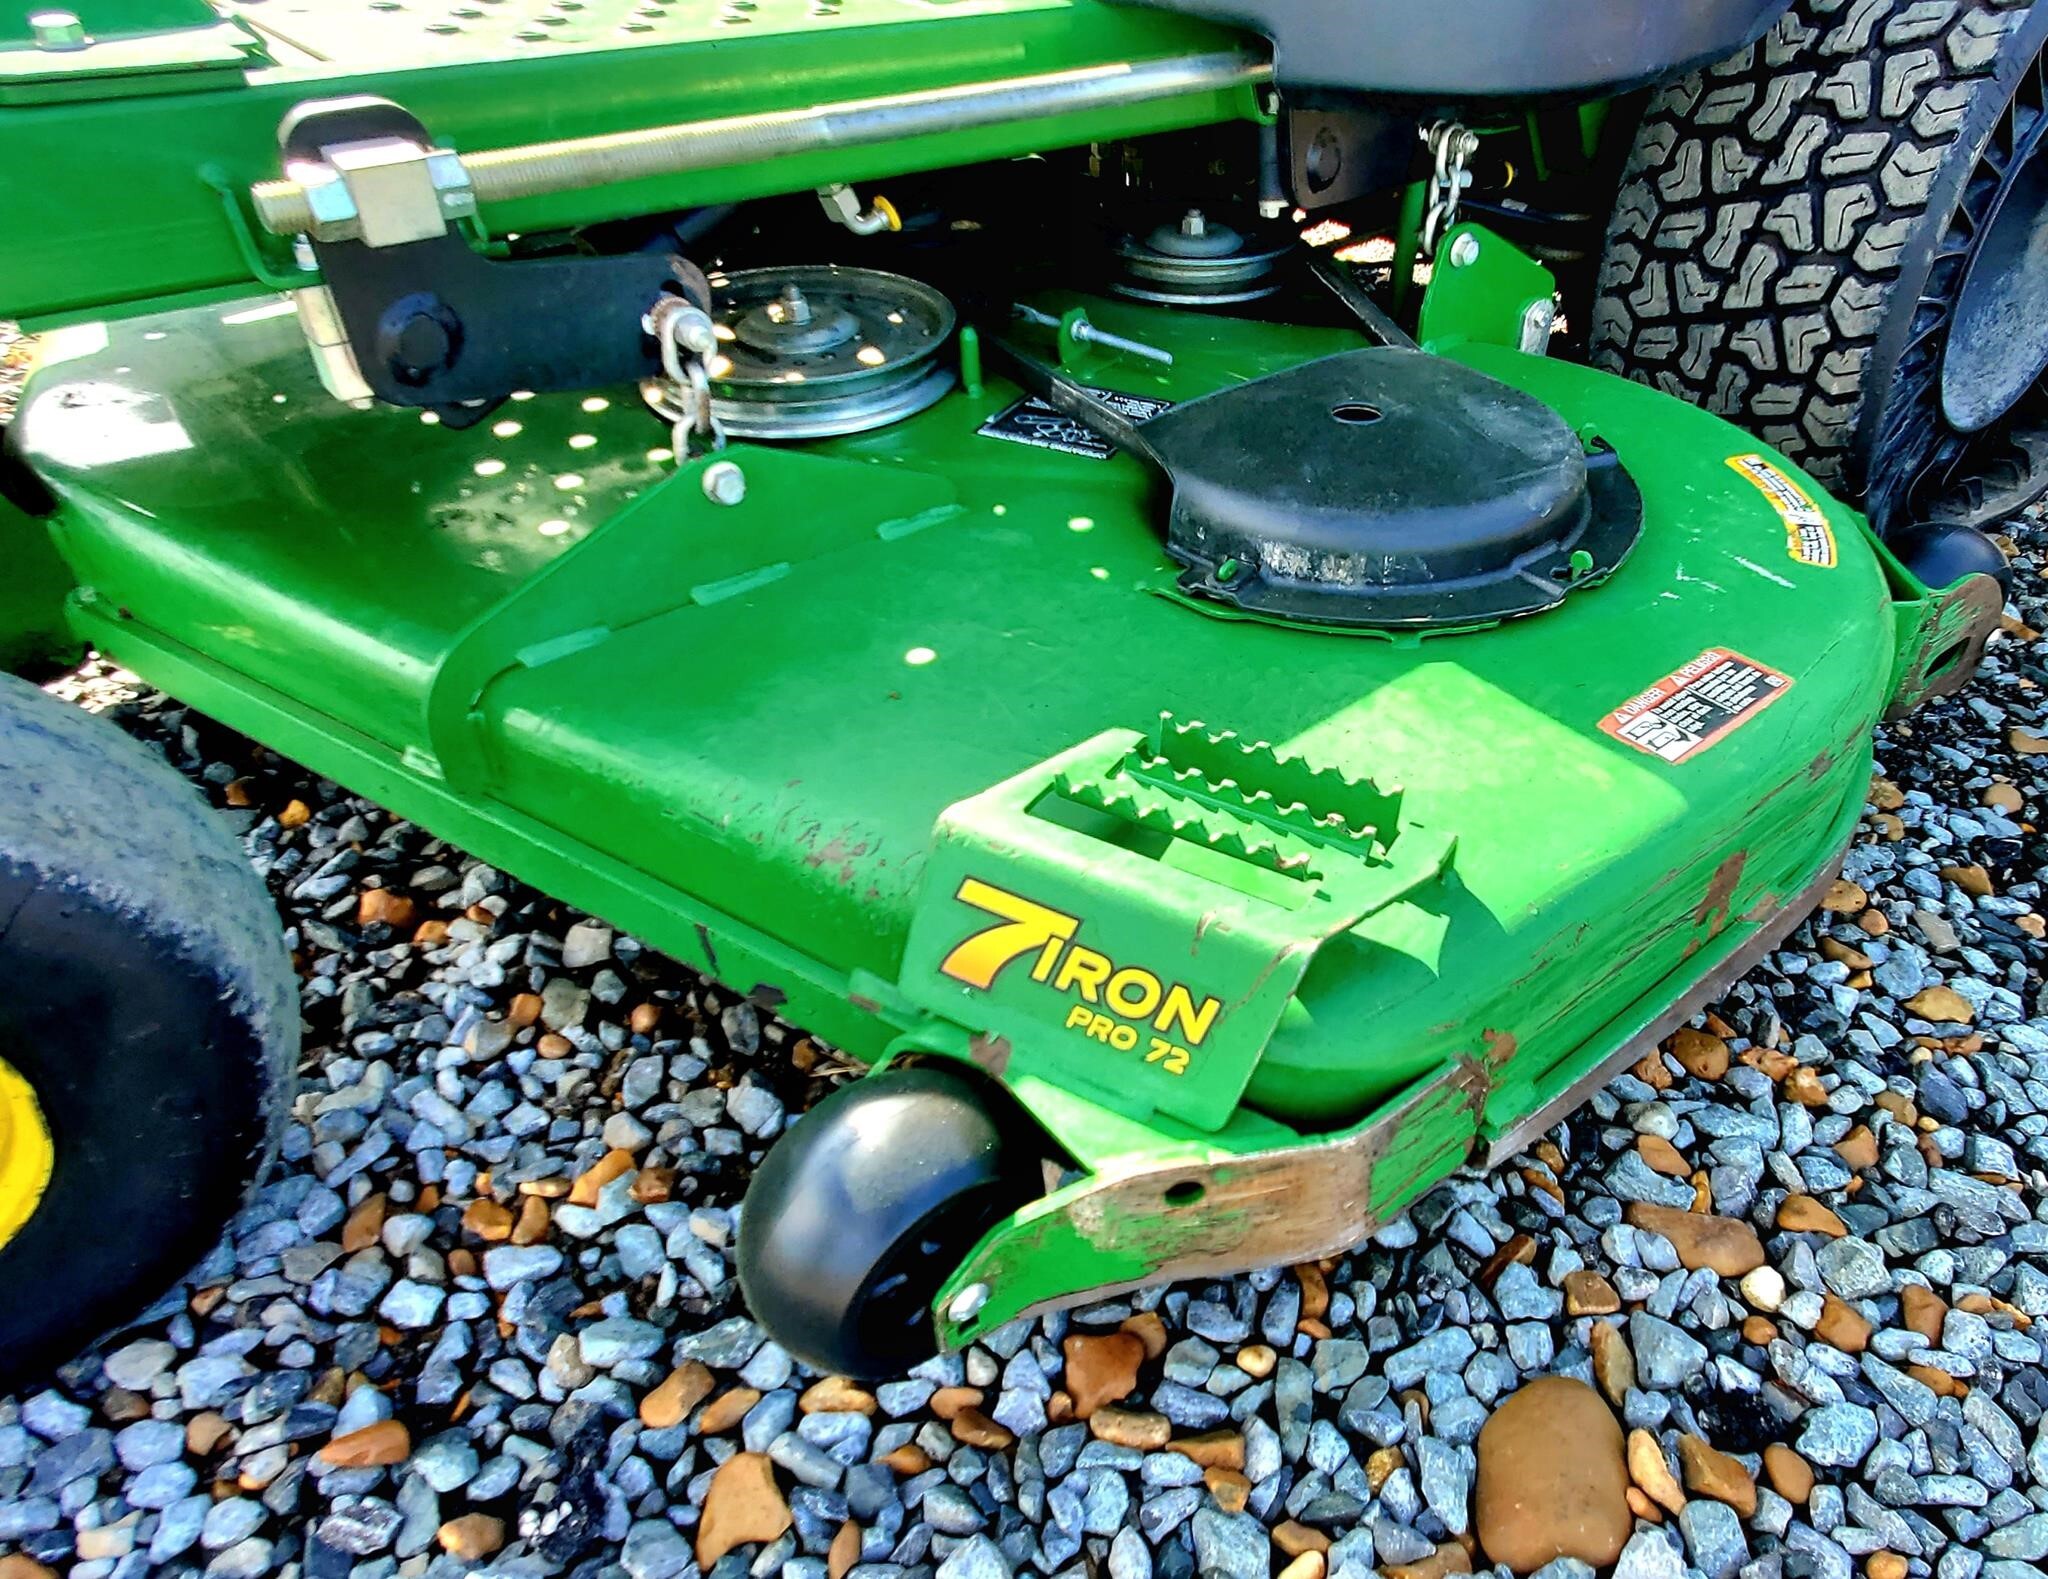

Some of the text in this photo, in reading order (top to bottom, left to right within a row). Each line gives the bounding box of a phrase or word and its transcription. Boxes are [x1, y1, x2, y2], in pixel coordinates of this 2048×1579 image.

[1624, 687, 1667, 715] DANGER
[1682, 651, 1723, 678] PELIGRO
[1065, 1004, 1191, 1075] PRO 72
